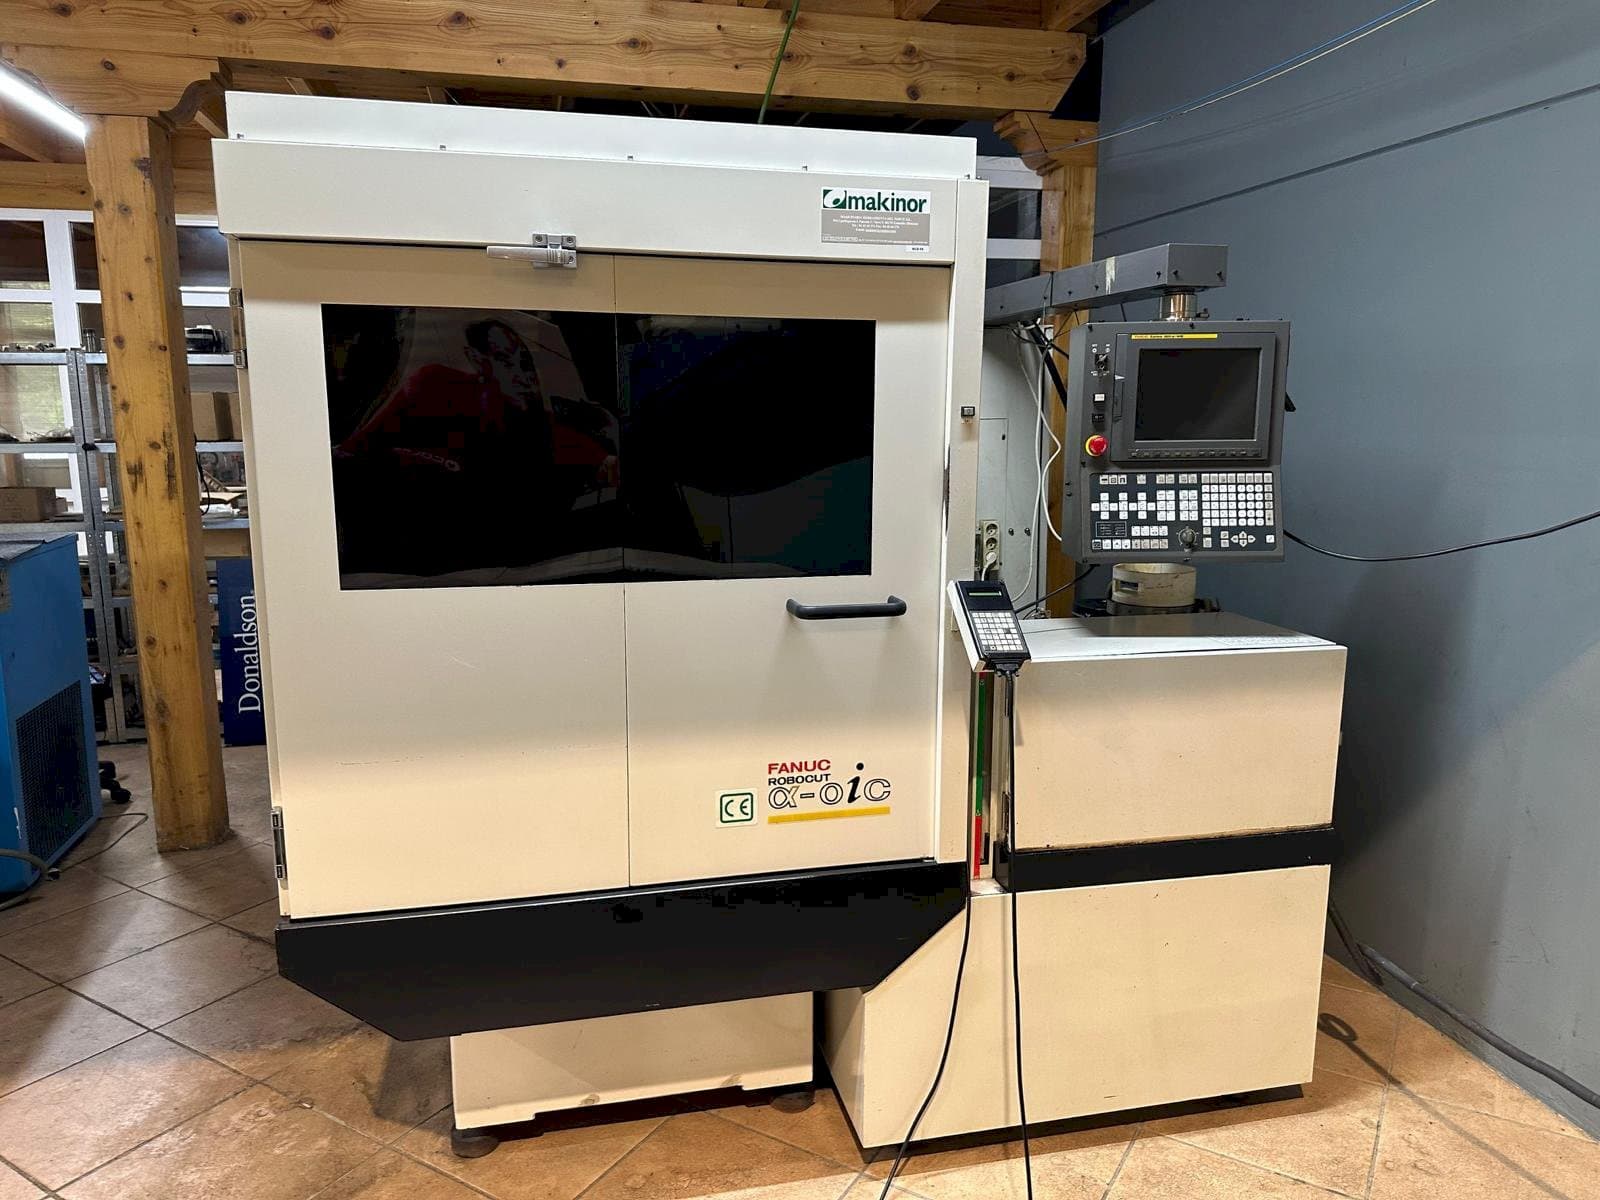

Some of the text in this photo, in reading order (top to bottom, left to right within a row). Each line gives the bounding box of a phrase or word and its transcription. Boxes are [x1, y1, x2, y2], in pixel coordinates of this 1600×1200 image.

[848, 192, 927, 213] makinor
[233, 595, 261, 714] Donaldson
[768, 759, 831, 775] FANUC
[768, 773, 832, 786] ROBOCUT
